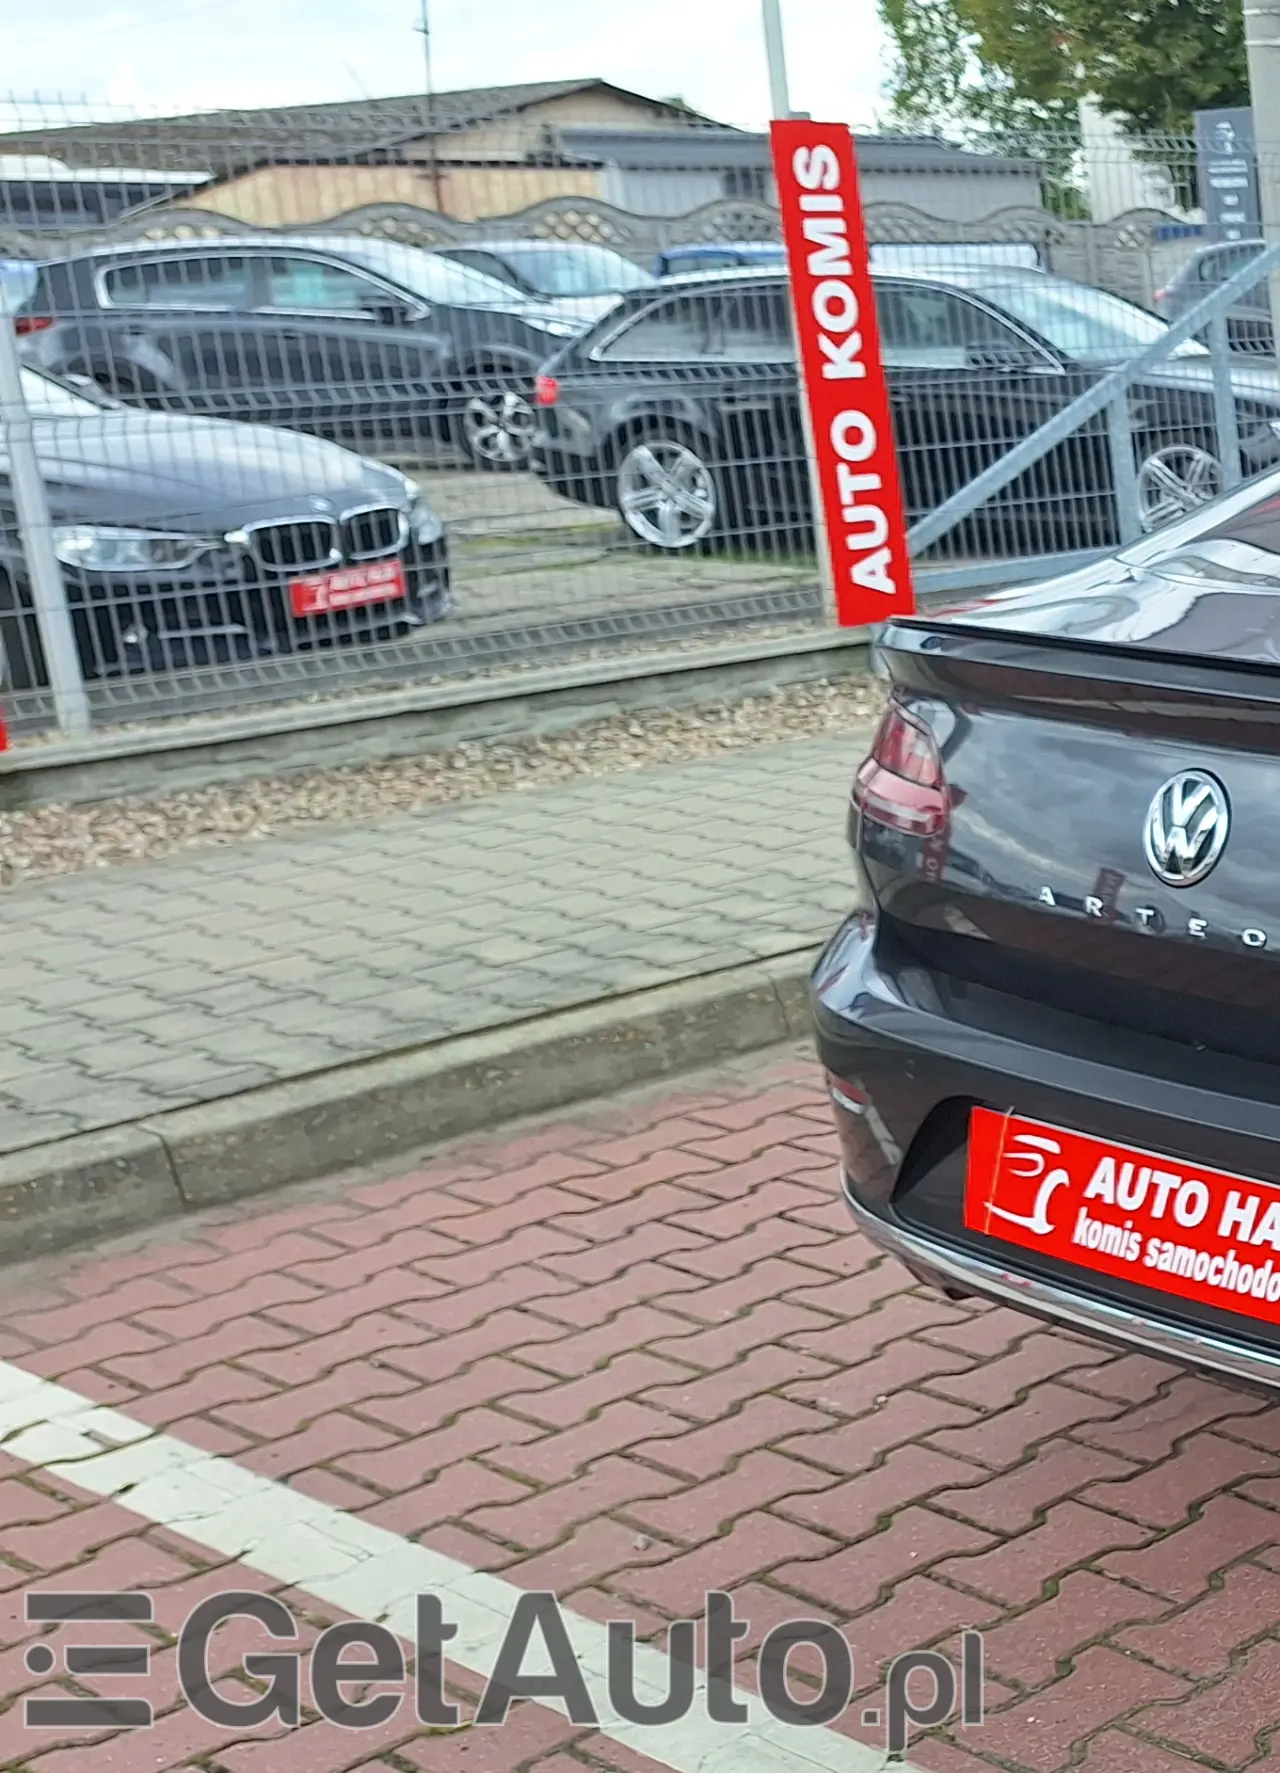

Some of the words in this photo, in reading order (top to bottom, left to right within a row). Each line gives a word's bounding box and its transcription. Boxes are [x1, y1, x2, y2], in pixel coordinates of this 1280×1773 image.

[792, 143, 868, 381] KOMIS
[829, 409, 897, 595] AUTO
[1072, 1205, 1143, 1263] komis
[1083, 1156, 1210, 1229] AUTO
